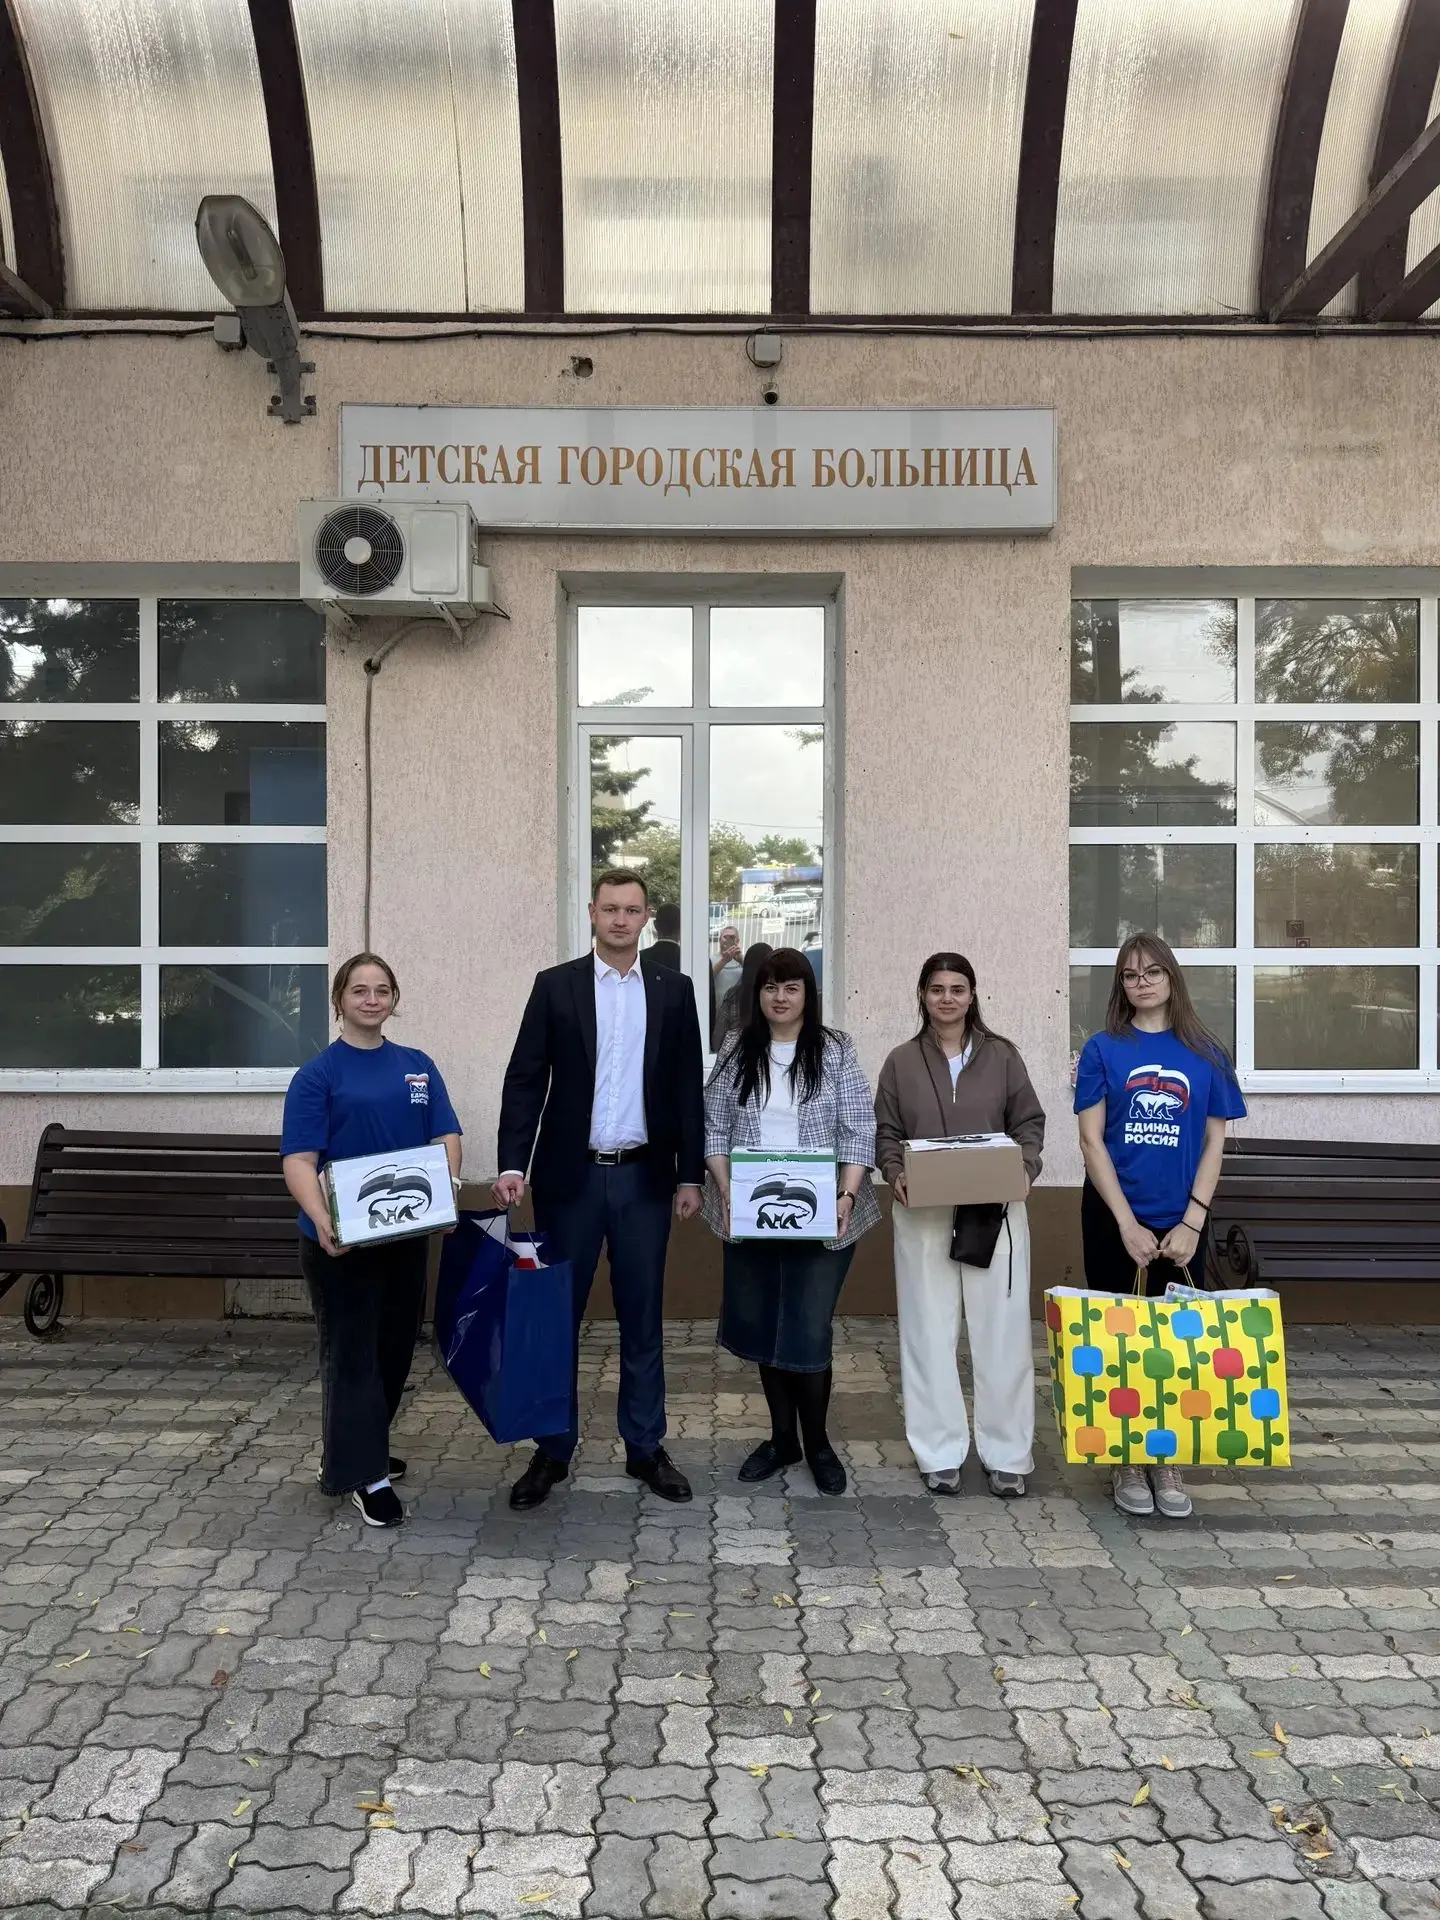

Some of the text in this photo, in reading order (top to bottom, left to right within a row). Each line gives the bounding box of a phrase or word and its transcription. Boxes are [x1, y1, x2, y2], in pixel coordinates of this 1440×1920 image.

[357, 444, 1038, 497] ДЕТСКАЯ ГОРОДСКАЯ БОЛЬНИЦА
[1125, 1122, 1180, 1135] ЕДИНАЯ
[1124, 1133, 1179, 1147] РОССИЯ
